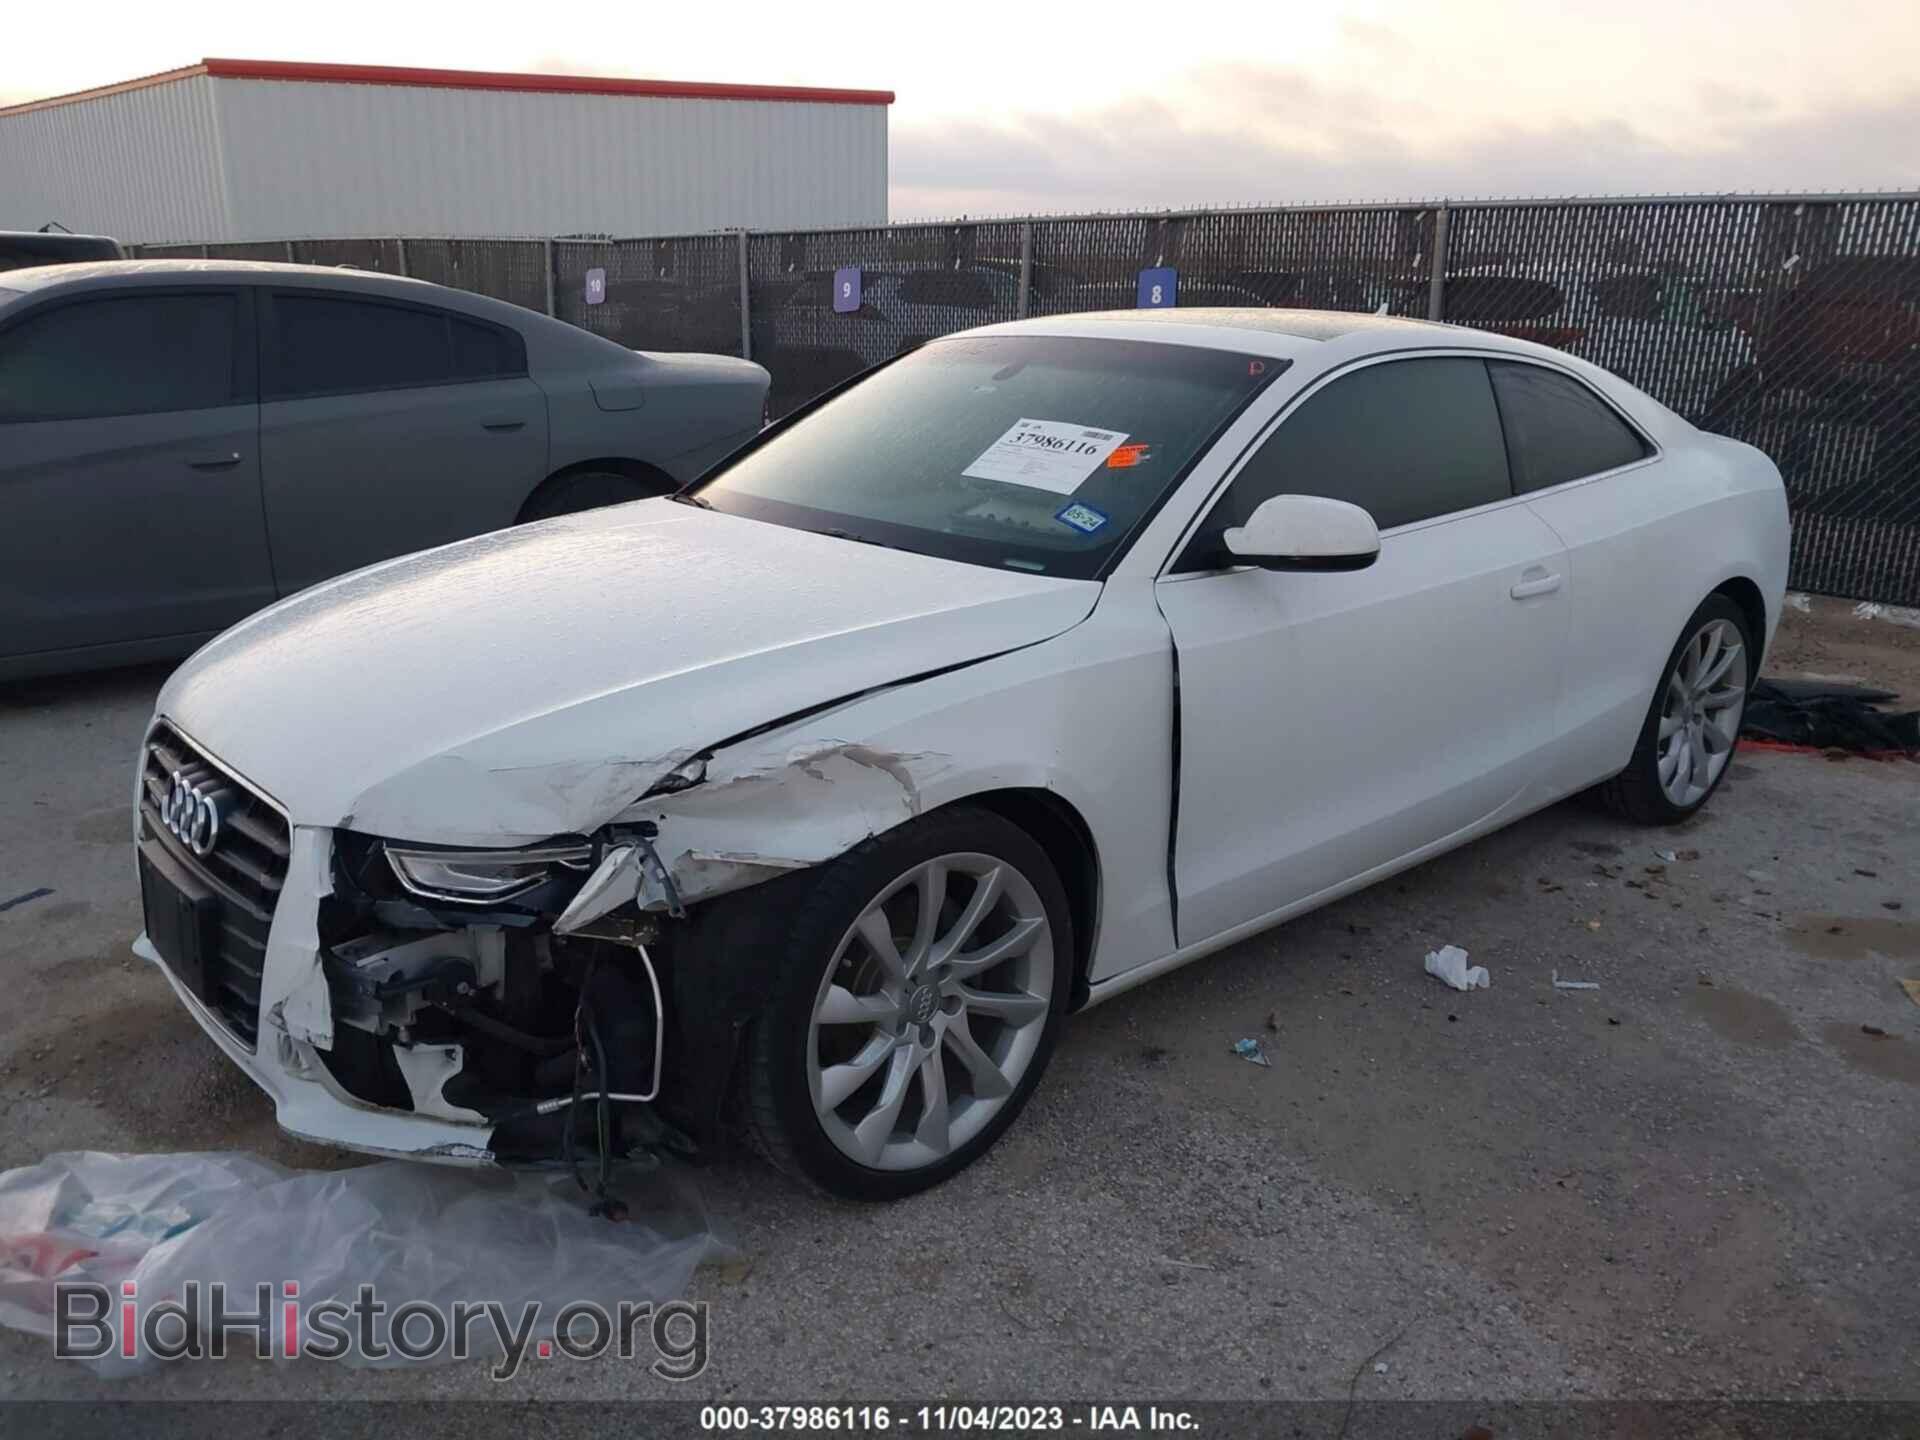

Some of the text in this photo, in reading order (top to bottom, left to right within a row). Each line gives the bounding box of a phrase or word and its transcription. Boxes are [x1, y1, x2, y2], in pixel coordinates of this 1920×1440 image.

[843, 282, 851, 298] 9
[1151, 285, 1162, 304] 8
[1009, 432, 1097, 456] 37986116
